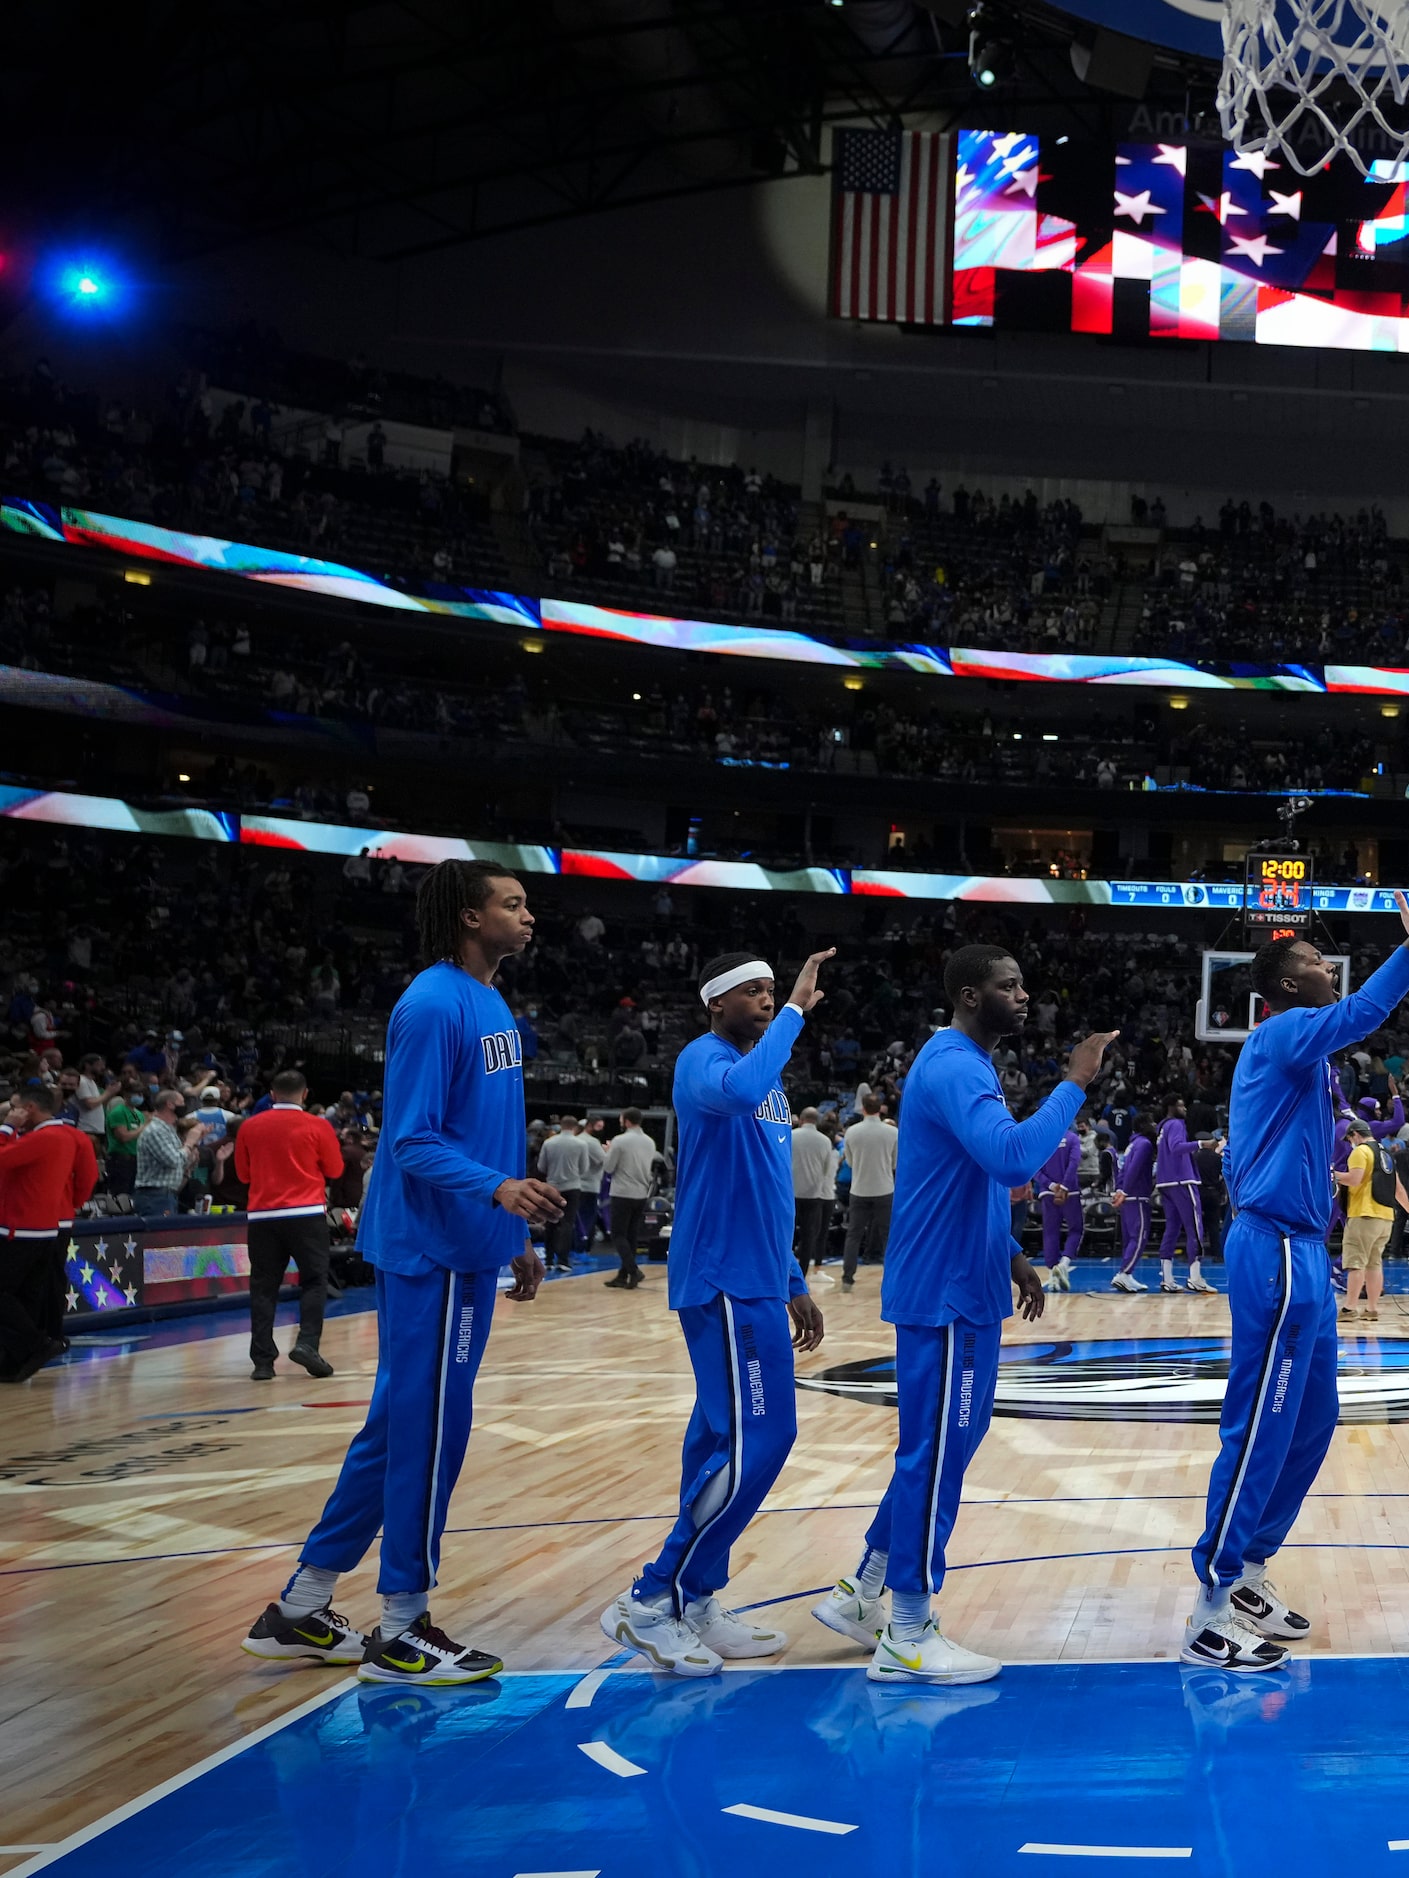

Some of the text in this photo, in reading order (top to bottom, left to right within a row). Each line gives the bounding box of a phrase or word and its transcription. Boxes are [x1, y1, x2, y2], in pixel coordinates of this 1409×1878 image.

[1262, 860, 1305, 879] 12:00
[1117, 885, 1148, 893] TIMEOUTS
[1212, 887, 1253, 895] MAVERICS
[1259, 878, 1299, 908] 24
[1313, 890, 1335, 898] KINGS
[1129, 892, 1170, 903] 7 0
[1228, 894, 1237, 905] 0
[1319, 897, 1393, 909] 0 0
[1265, 914, 1307, 923] TISSOT
[1115, 1114, 1122, 1126] 6
[455, 1306, 474, 1364] MAVERICKS
[741, 1324, 765, 1416] DALLAS MAVERICKS
[958, 1333, 976, 1427] DALLAS MAVERICKS
[1272, 1358, 1292, 1413] MAVERICKS
